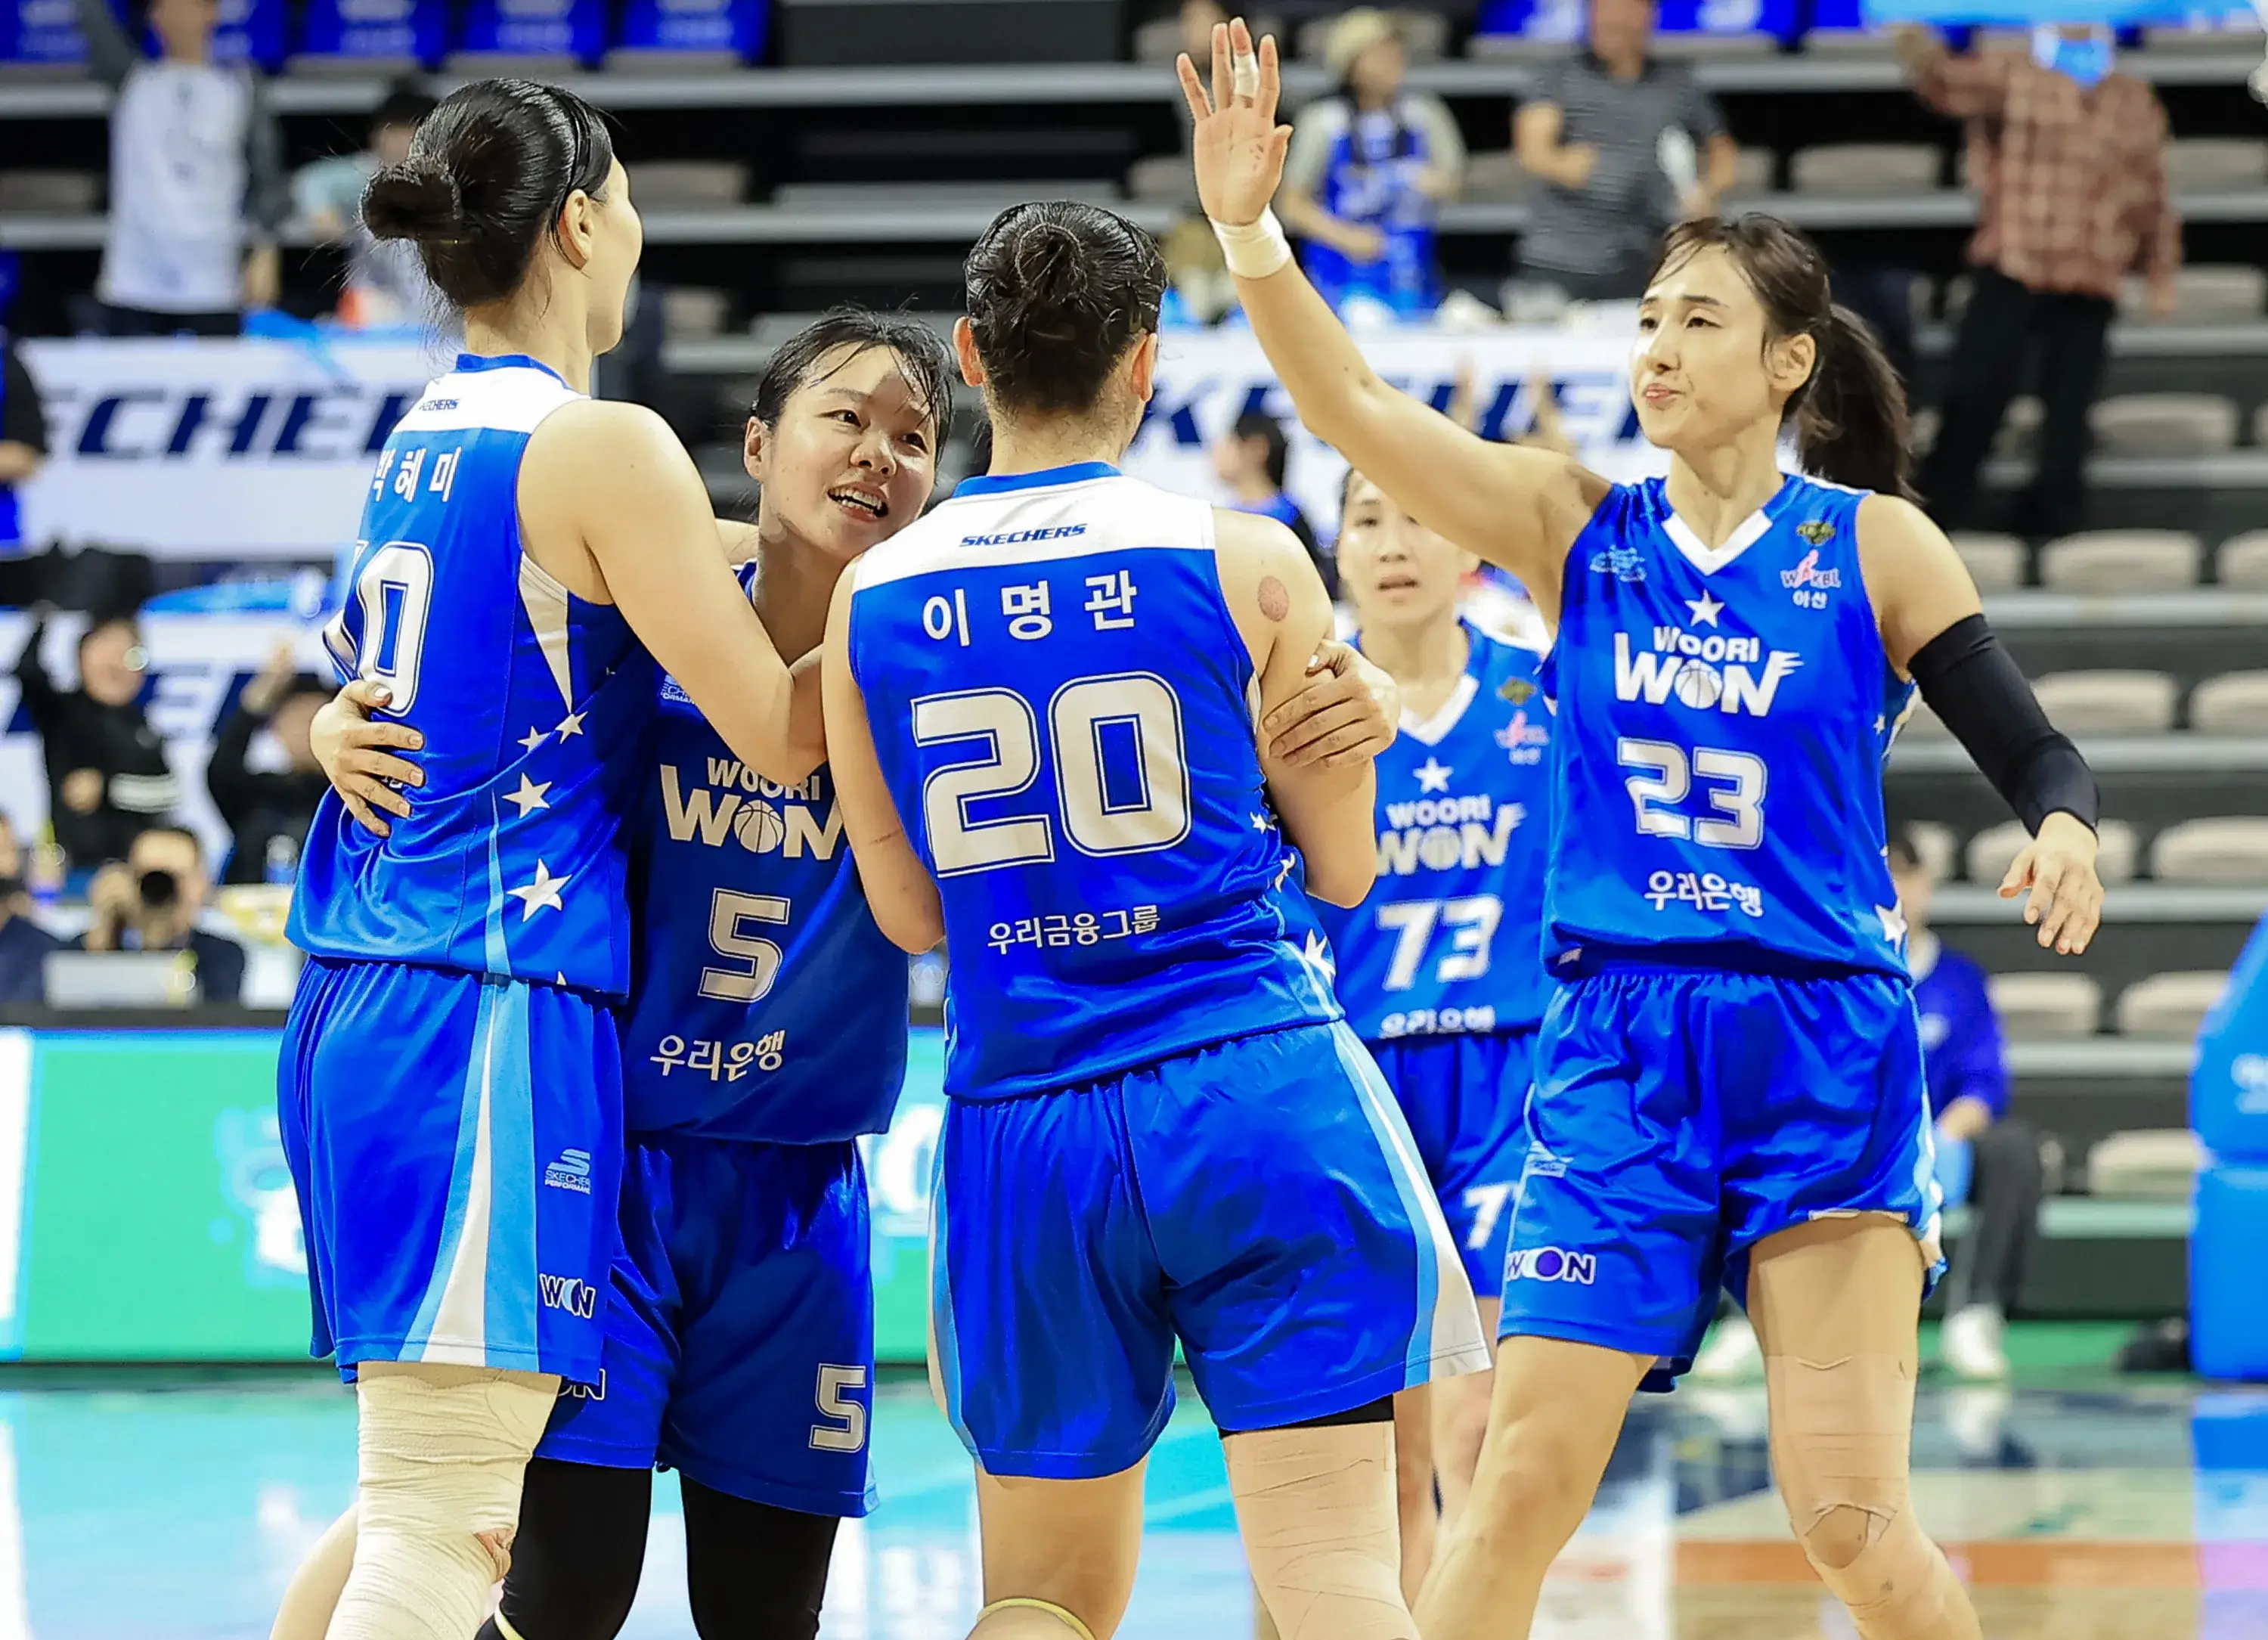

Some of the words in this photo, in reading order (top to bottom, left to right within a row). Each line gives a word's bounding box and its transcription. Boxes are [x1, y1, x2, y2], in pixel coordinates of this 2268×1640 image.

[959, 524, 1087, 547] SKECHERS
[1614, 633, 1805, 718] WON
[1653, 626, 1759, 662] WOORI
[910, 671, 1191, 879] 20
[1617, 736, 1768, 850] 23
[1385, 793, 1492, 829] WOORI
[987, 905, 1160, 955] 우리금융그룹
[1644, 871, 1764, 918] 우리은행
[697, 887, 791, 1003] 5
[1376, 893, 1504, 992] 73
[649, 1029, 785, 1082] 우리은행
[1463, 1180, 1520, 1251] 7
[808, 1363, 866, 1453] 5
